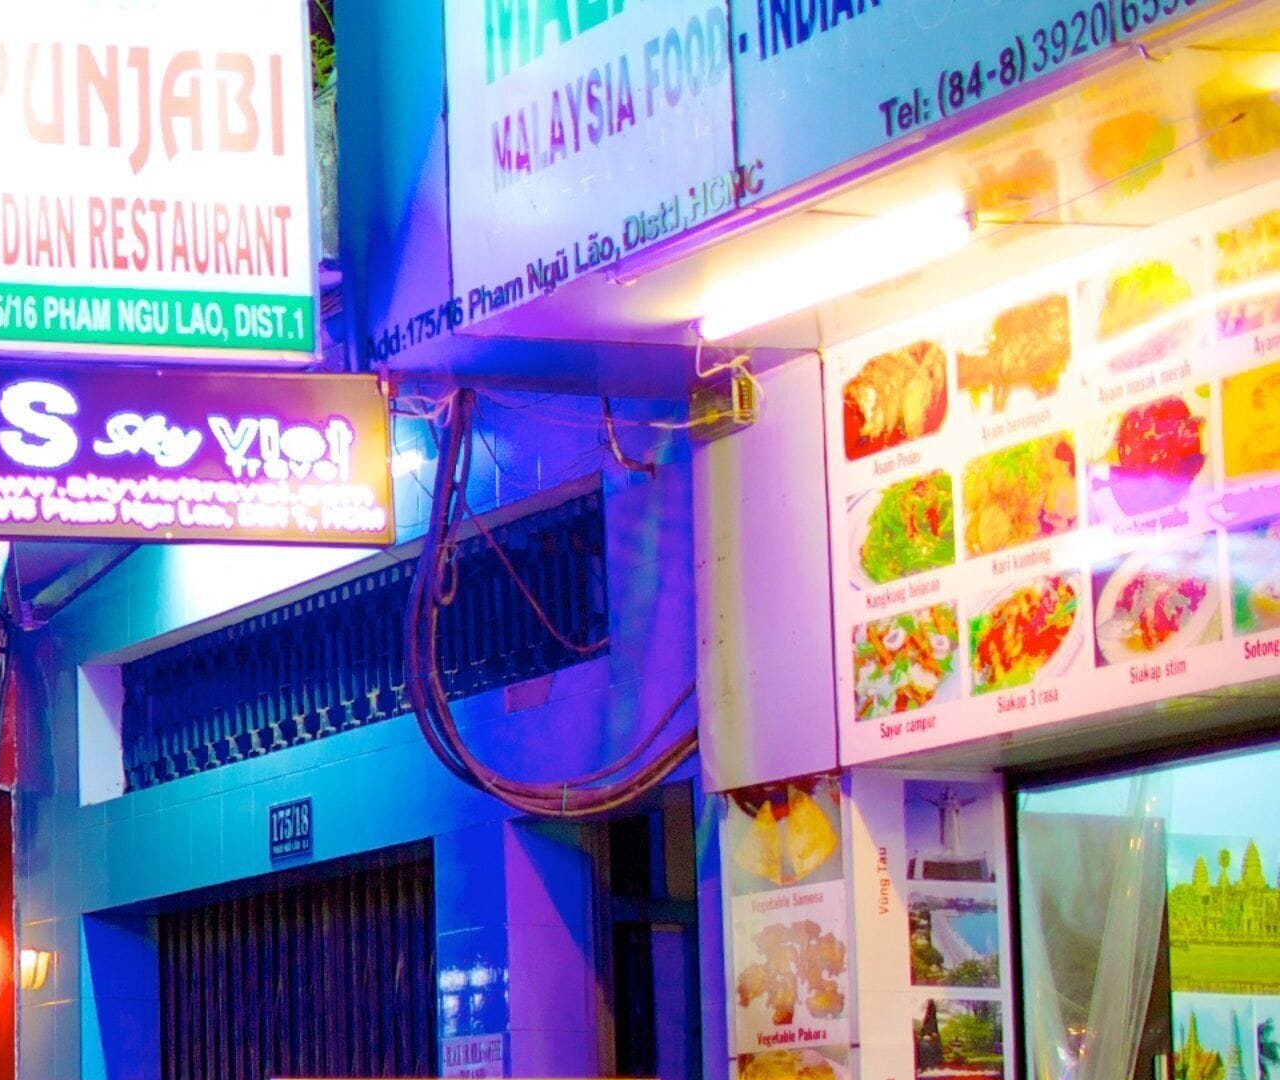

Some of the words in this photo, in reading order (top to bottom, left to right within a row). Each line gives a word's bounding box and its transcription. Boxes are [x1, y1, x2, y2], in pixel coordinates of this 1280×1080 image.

[491, 54, 636, 194] MALAYSIA
[644, 6, 728, 118] FOOD
[878, 88, 931, 137] Tel:
[89, 196, 293, 278] RESTAURANT
[44, 296, 112, 333] PHAM
[118, 299, 170, 336] NGU
[175, 302, 230, 343] LAO,
[235, 304, 306, 341] DIST.1
